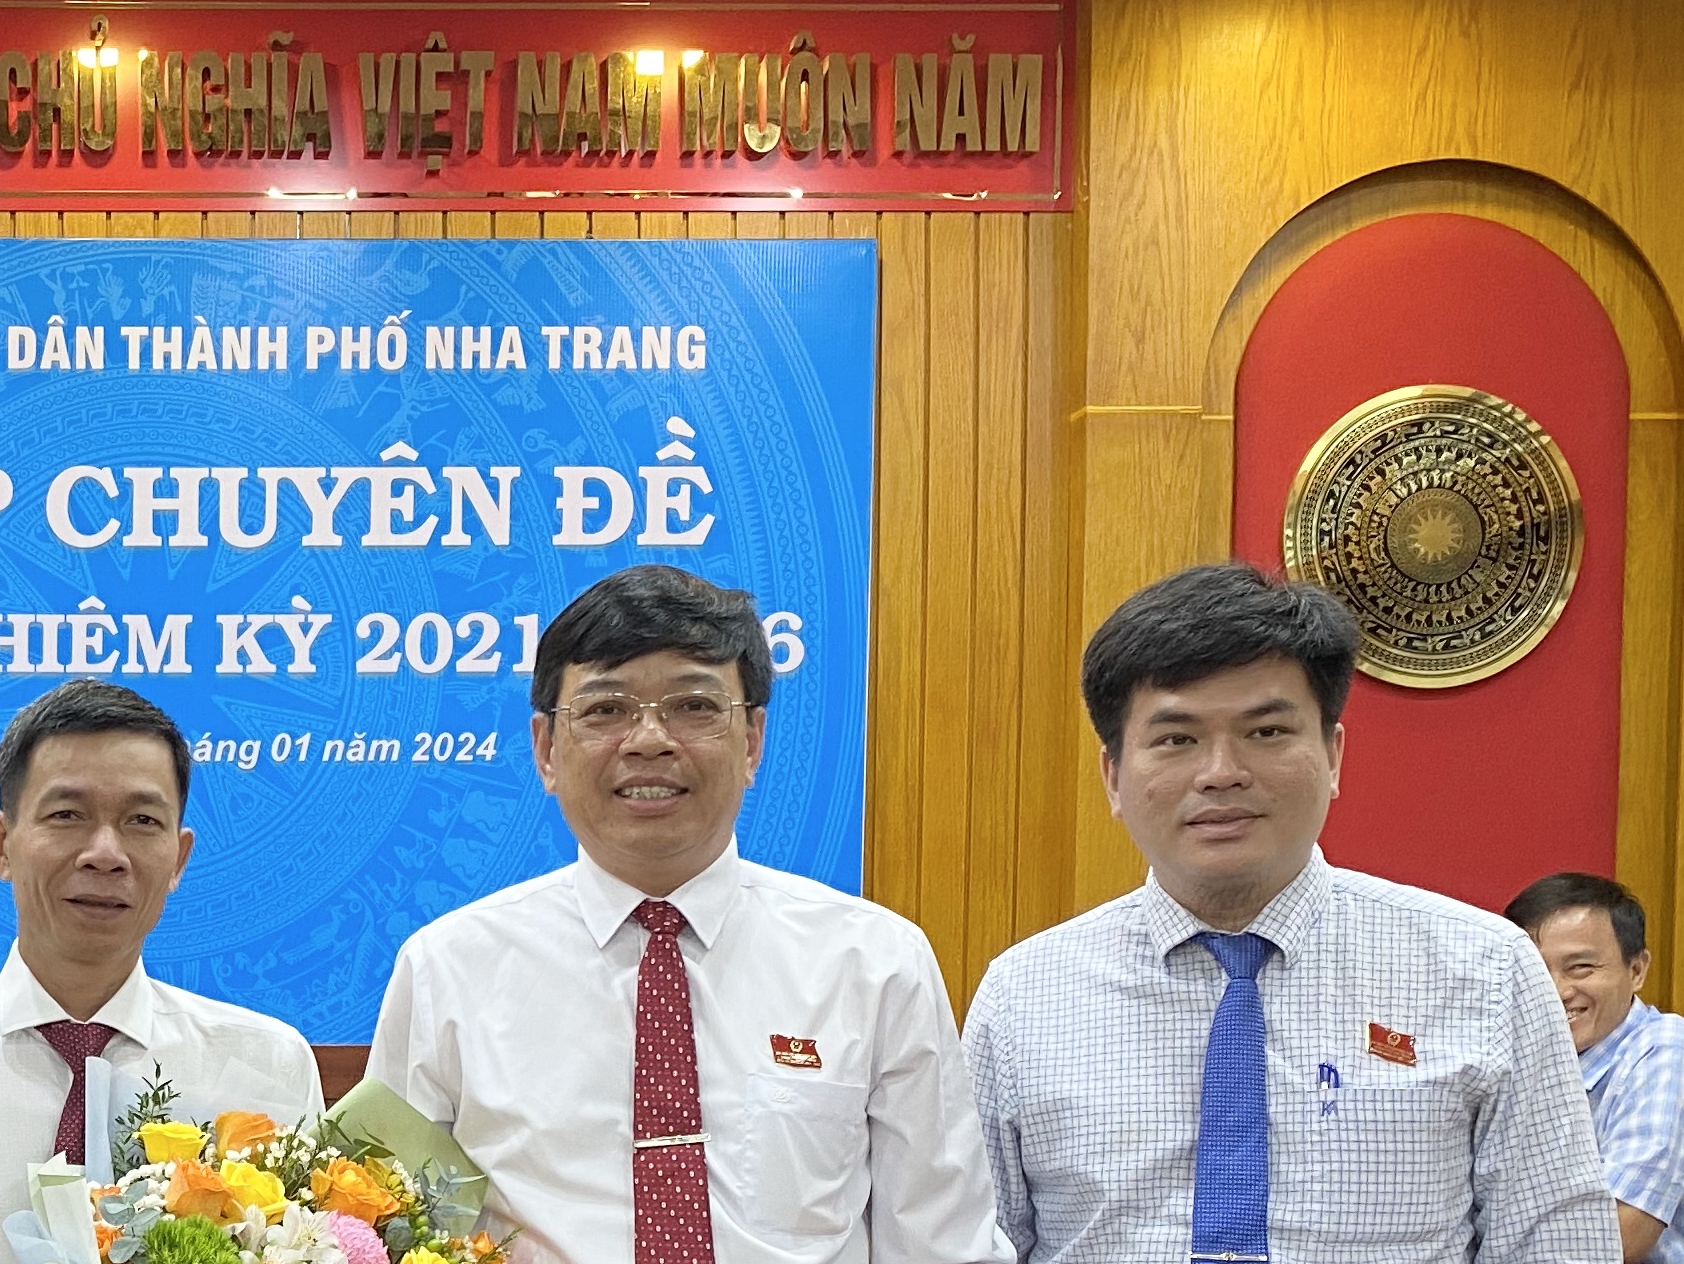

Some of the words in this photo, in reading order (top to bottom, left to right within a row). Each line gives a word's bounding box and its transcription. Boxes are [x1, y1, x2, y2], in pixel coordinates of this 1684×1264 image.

[138, 30, 330, 155] NGHĨA
[358, 31, 496, 175] VIỆT
[516, 50, 664, 154] NAM
[680, 31, 871, 154] MUÔN
[892, 32, 1045, 153] NĂM
[8, 315, 105, 371] DÂN
[120, 316, 288, 371] THÀNH
[306, 310, 413, 371] PHỐ
[425, 325, 527, 371] NHA
[541, 325, 707, 373] TRANG
[46, 441, 521, 548] CHUYÊN
[552, 416, 716, 546] ĐỀ
[215, 595, 333, 674] KỲ
[188, 732, 261, 770] áng
[271, 732, 311, 762] 01
[322, 732, 401, 762] năm
[412, 732, 498, 762] 2024
